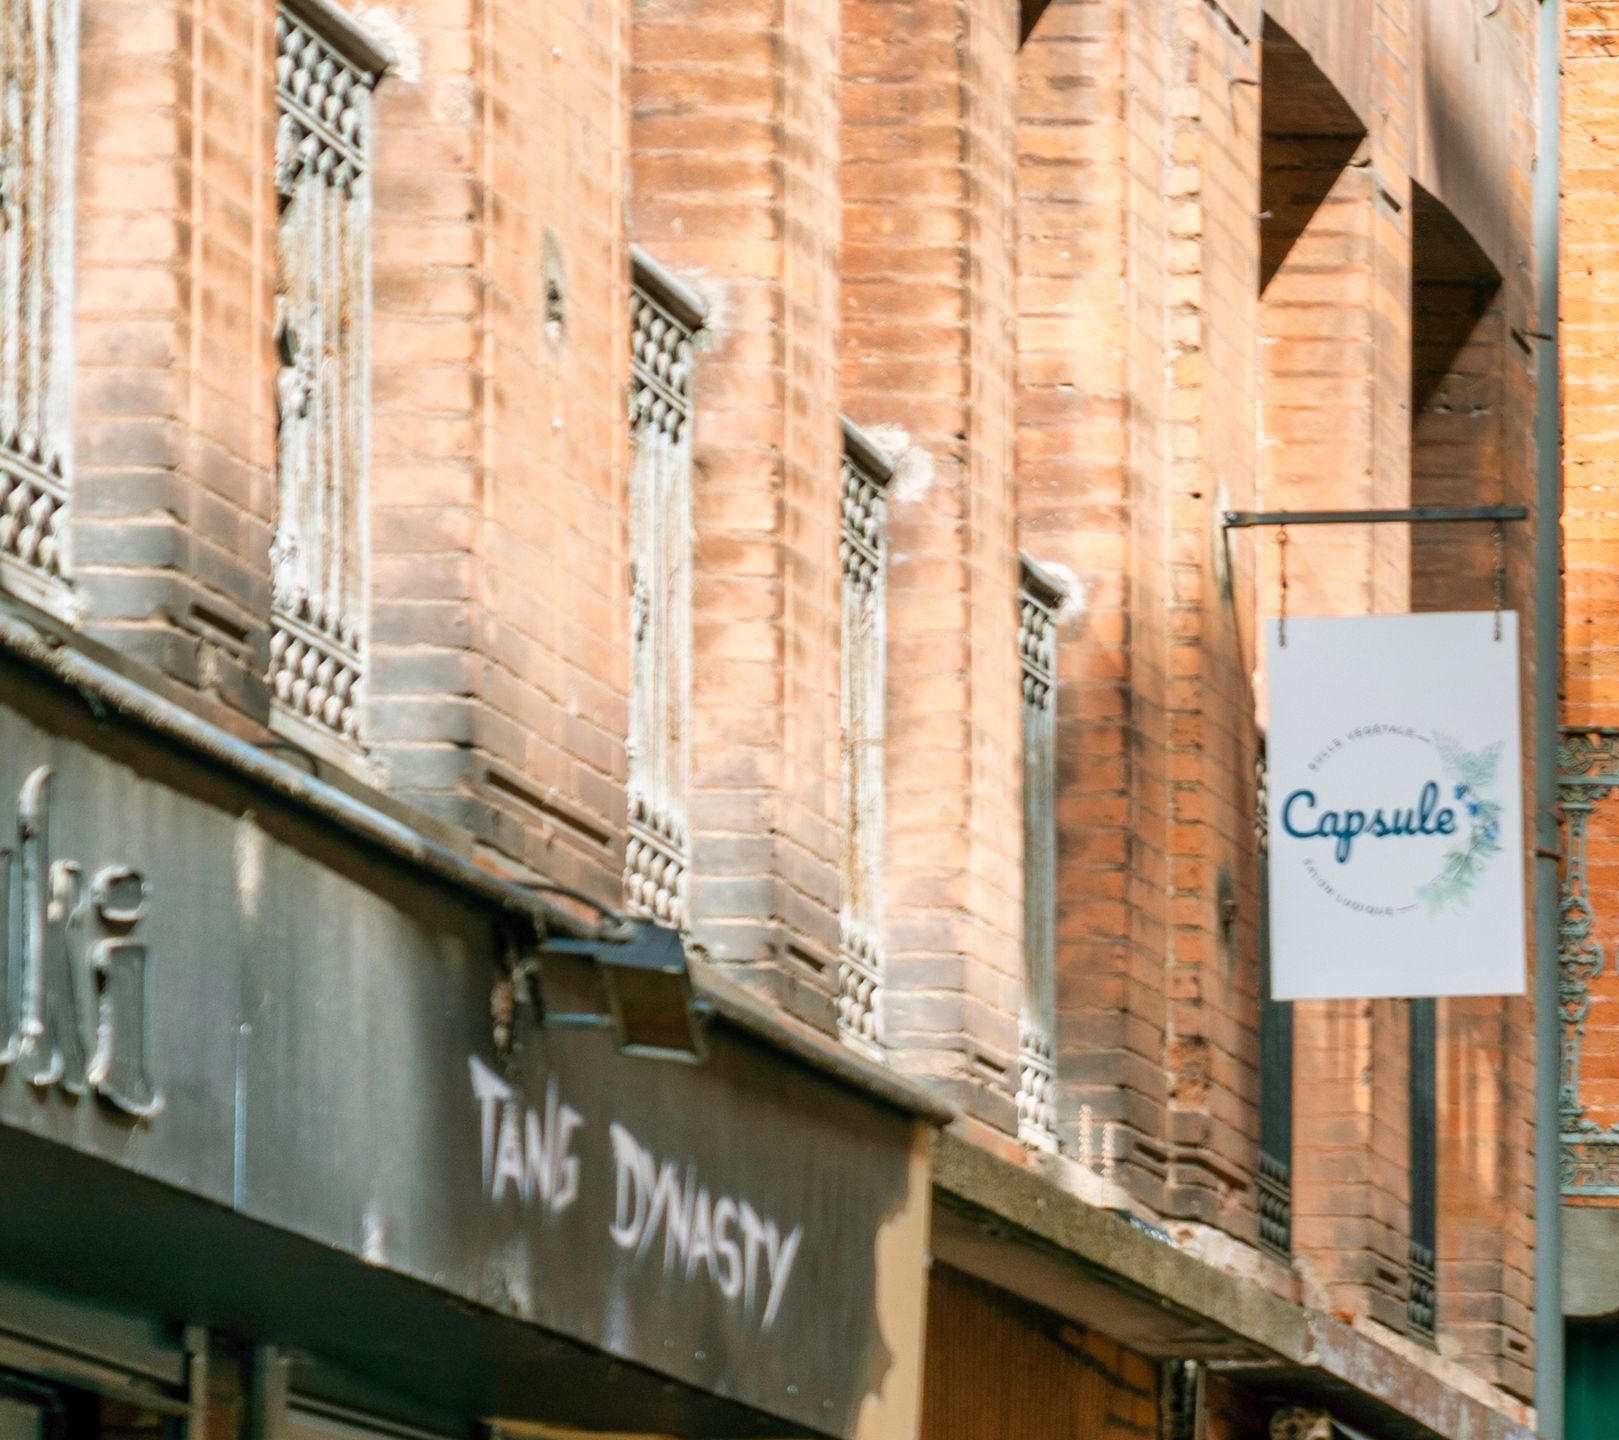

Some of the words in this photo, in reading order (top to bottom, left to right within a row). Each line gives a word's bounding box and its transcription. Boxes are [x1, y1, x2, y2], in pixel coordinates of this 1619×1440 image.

[1280, 779, 1458, 865] Capsule
[468, 1054, 585, 1215] TANG
[608, 1121, 803, 1328] DYNASTY
